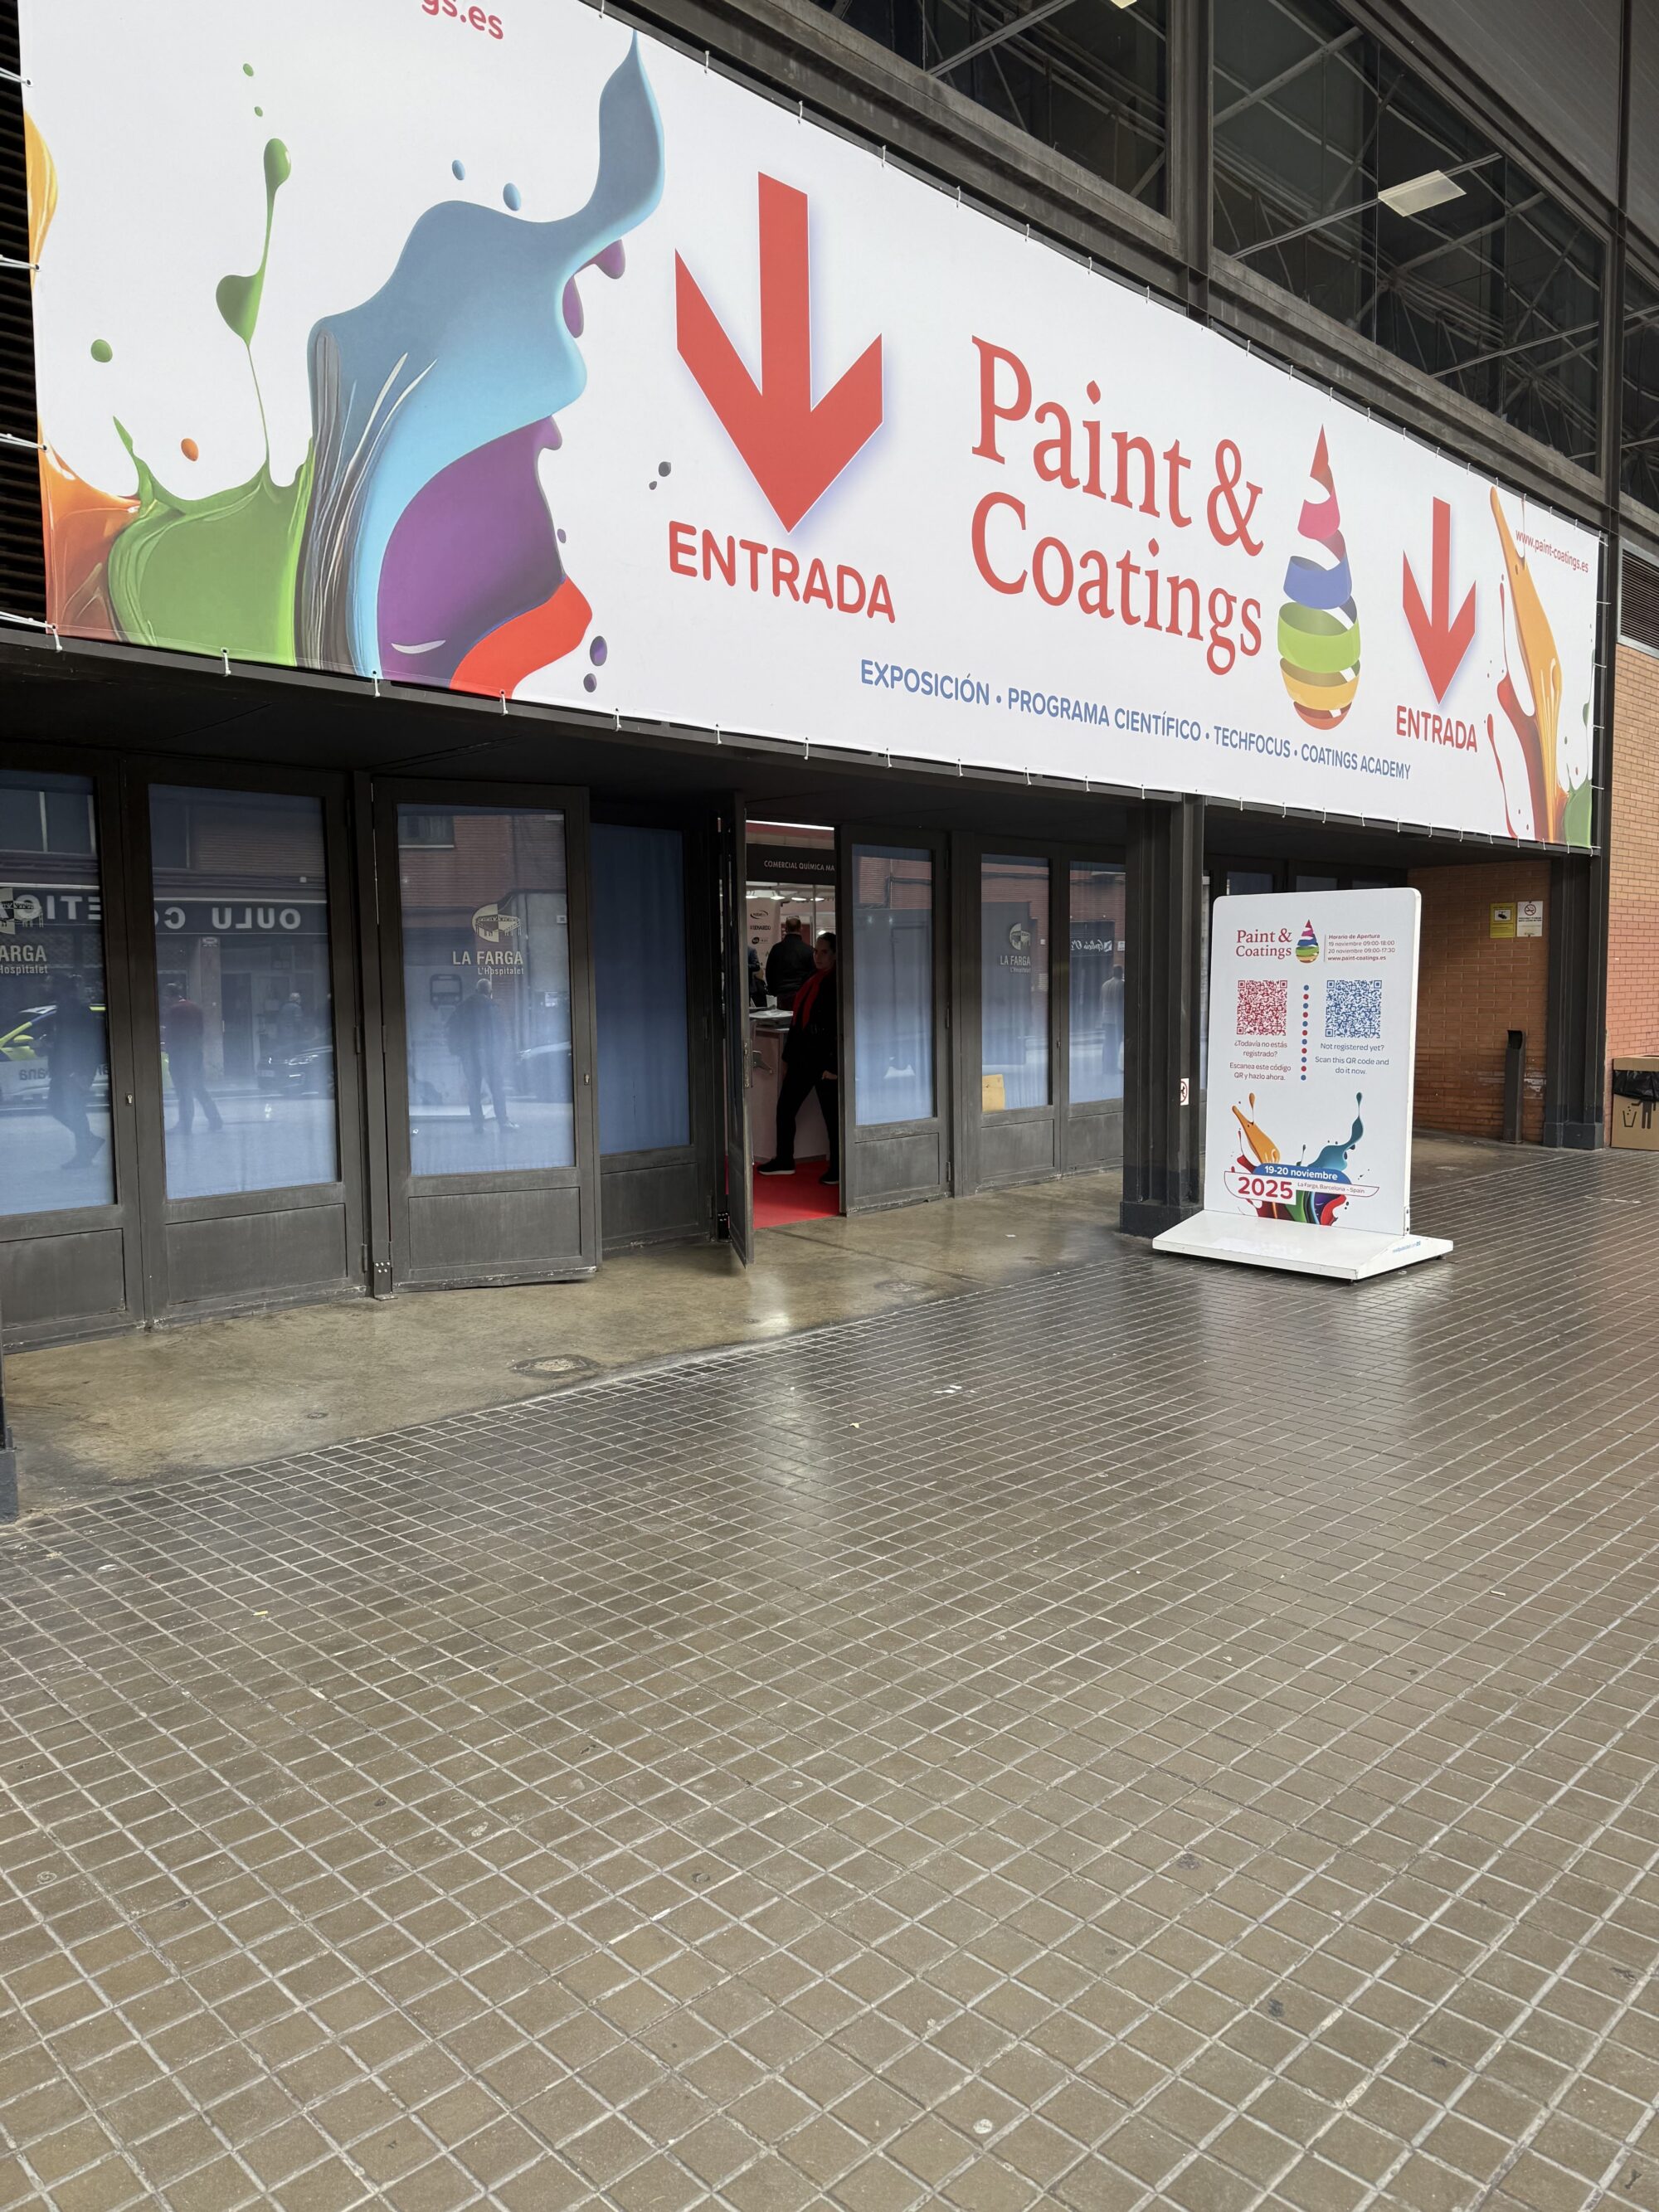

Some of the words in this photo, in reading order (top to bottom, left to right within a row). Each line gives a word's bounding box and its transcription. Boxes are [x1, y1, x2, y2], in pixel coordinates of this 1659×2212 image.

[971, 335, 1192, 527] Paint
[1206, 439, 1264, 557] &
[1515, 530, 1588, 572] www.paint-coatings.es
[669, 521, 896, 624] ENTRADA
[971, 491, 1262, 675] Coatings
[860, 659, 990, 705] EXPOSICIÓN
[1008, 688, 1110, 727] PROGRAMA
[1114, 707, 1201, 741] CIENTÍFICO
[1214, 726, 1291, 758] TECHFOCUS
[1301, 743, 1358, 770] COATINGS
[1360, 756, 1411, 780] ACADEMY
[1396, 705, 1477, 752] ENTRADA
[764, 860, 797, 869] COMERCIAL
[799, 861, 825, 871] QUÍMICA
[1237, 929, 1275, 943] Paint
[1277, 928, 1292, 942] &
[452, 951, 471, 965] LA
[476, 951, 523, 965] FARGA
[1000, 955, 1009, 965] LA
[1010, 955, 1030, 965] FARGA
[1236, 945, 1292, 960] Coatings
[478, 967, 524, 975] L'Hospitalet
[1270, 1064, 1292, 1072] código
[1265, 1165, 1288, 1175] 19-20
[1290, 1169, 1338, 1180] noviembre
[1238, 1176, 1293, 1199] 2025
[1320, 1184, 1345, 1192] Barcelona
